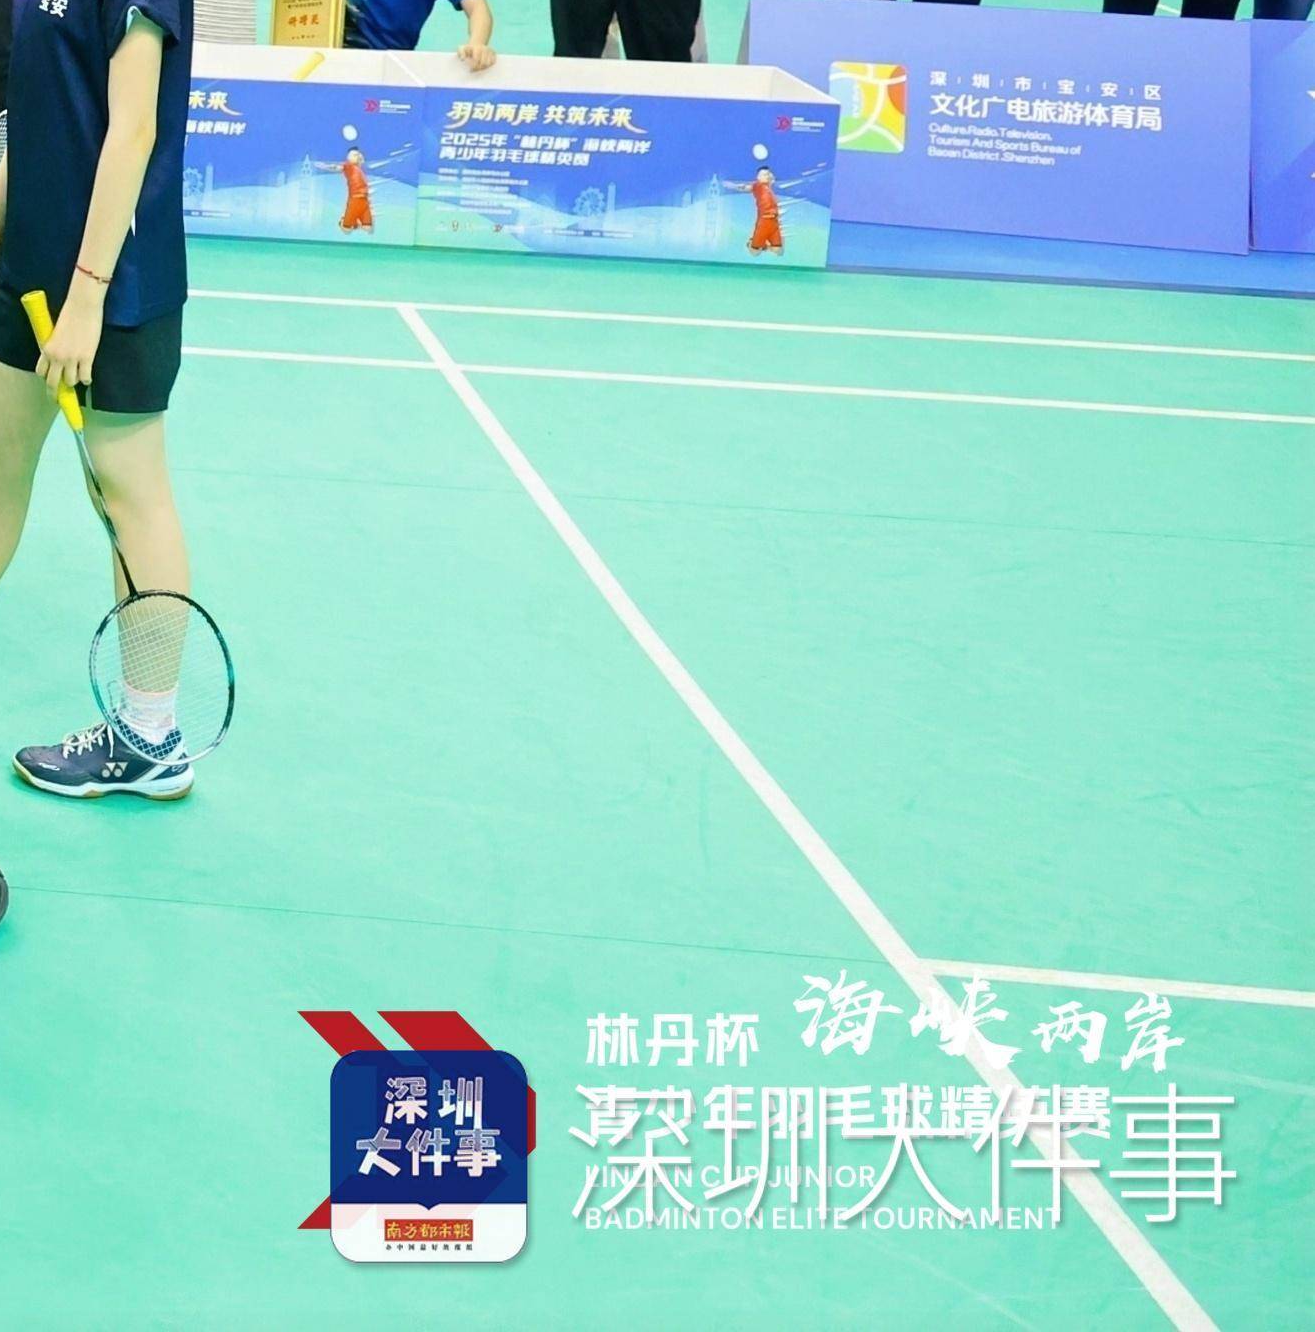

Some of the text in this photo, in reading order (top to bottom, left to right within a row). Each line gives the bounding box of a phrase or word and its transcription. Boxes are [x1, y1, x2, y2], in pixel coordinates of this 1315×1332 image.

[929, 92, 1162, 131] 文化广电旅游体育局
[929, 134, 1082, 155] Tourism And Sports Bureau of
